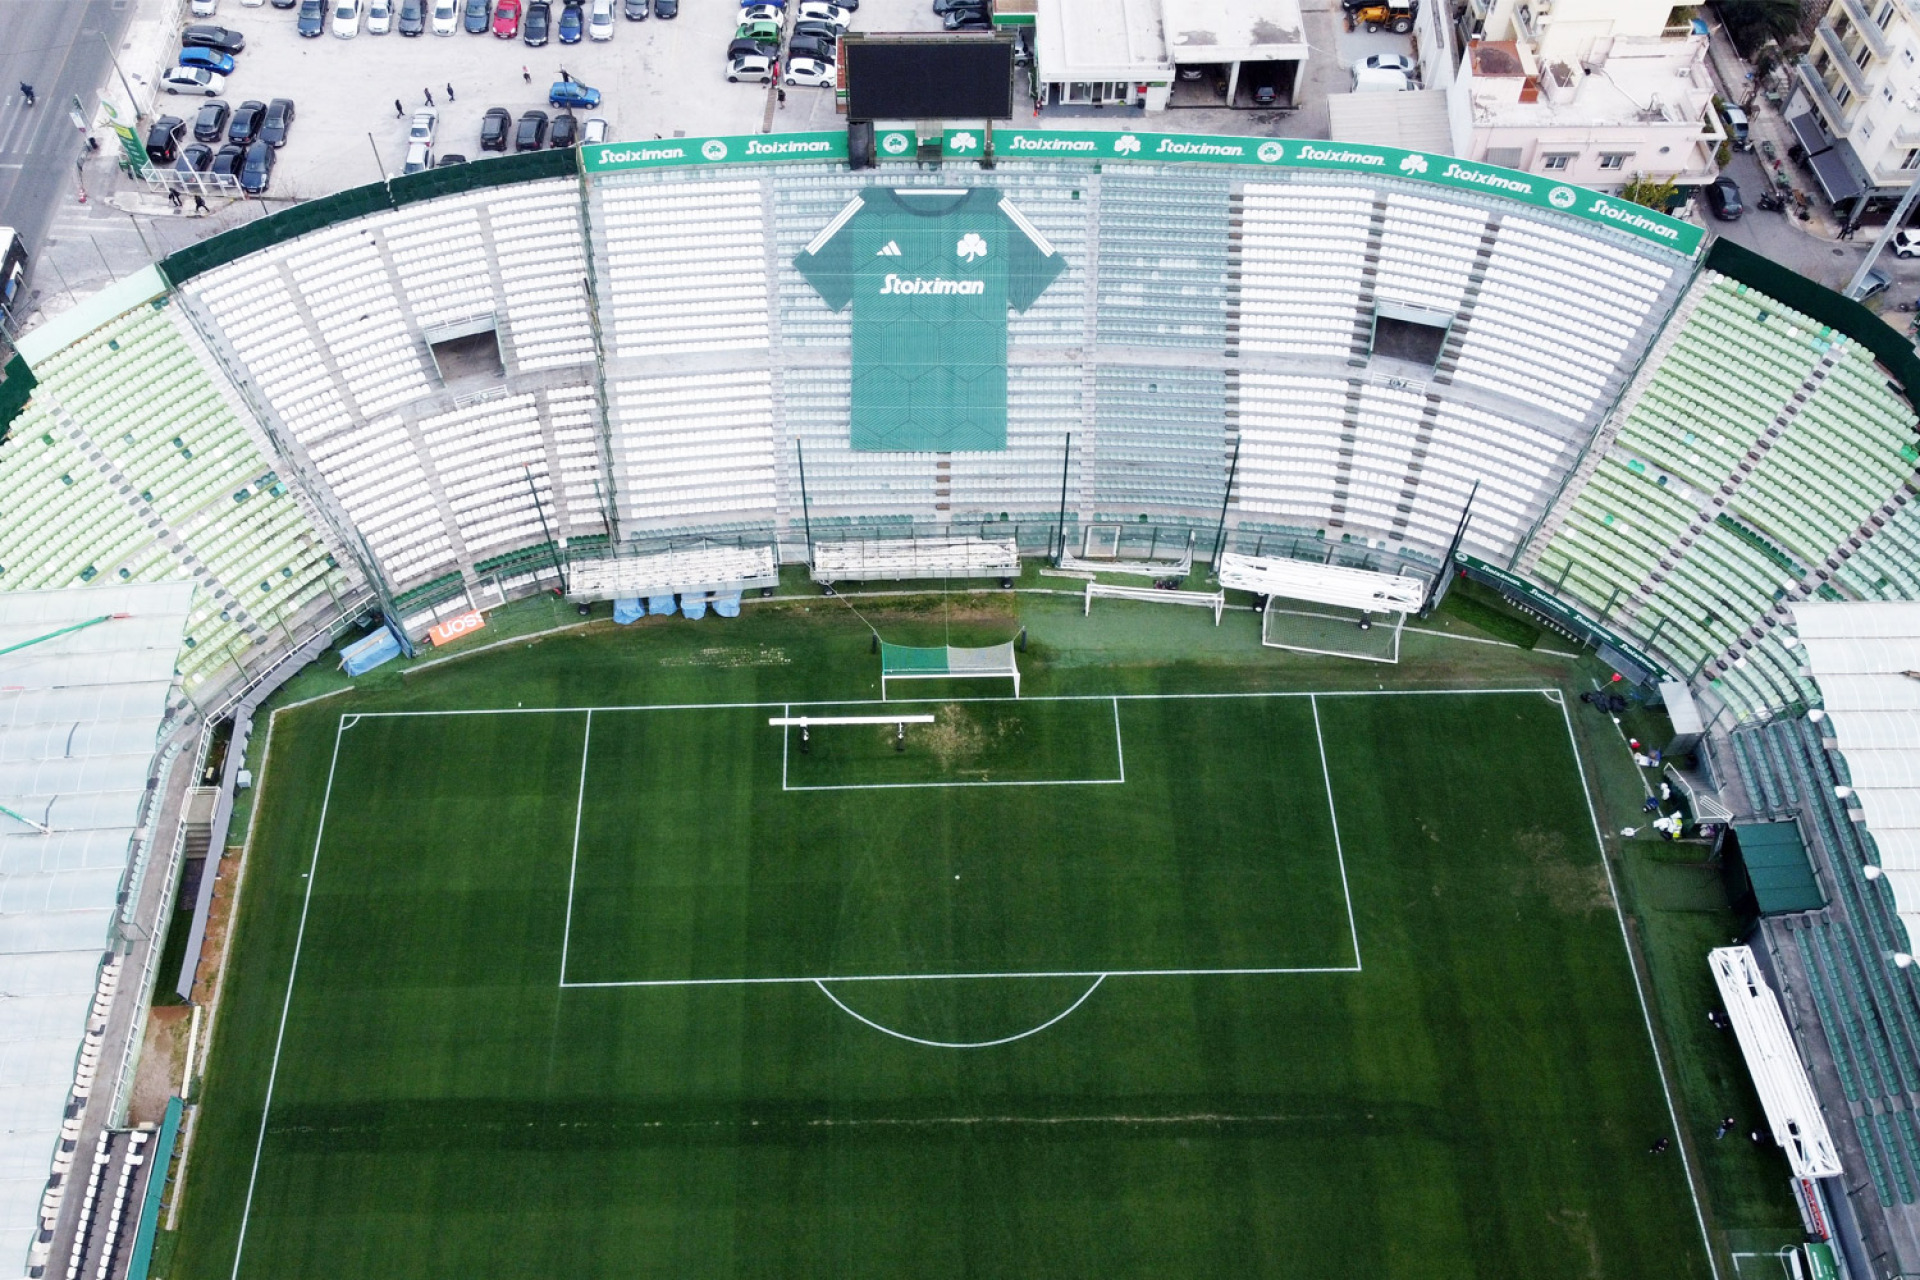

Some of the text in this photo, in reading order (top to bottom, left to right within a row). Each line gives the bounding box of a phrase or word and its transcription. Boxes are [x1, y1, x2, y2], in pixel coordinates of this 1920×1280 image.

[745, 140, 830, 155] Stoiximan
[1009, 136, 1096, 151] Stoiximan
[1156, 138, 1244, 156] Stoiximan
[599, 148, 685, 165] Stoiximan
[1296, 145, 1385, 166] Stoiximan
[1442, 163, 1532, 194] Stoiximan
[1588, 199, 1679, 240] Stoiximan
[880, 273, 985, 295] Stoiximan
